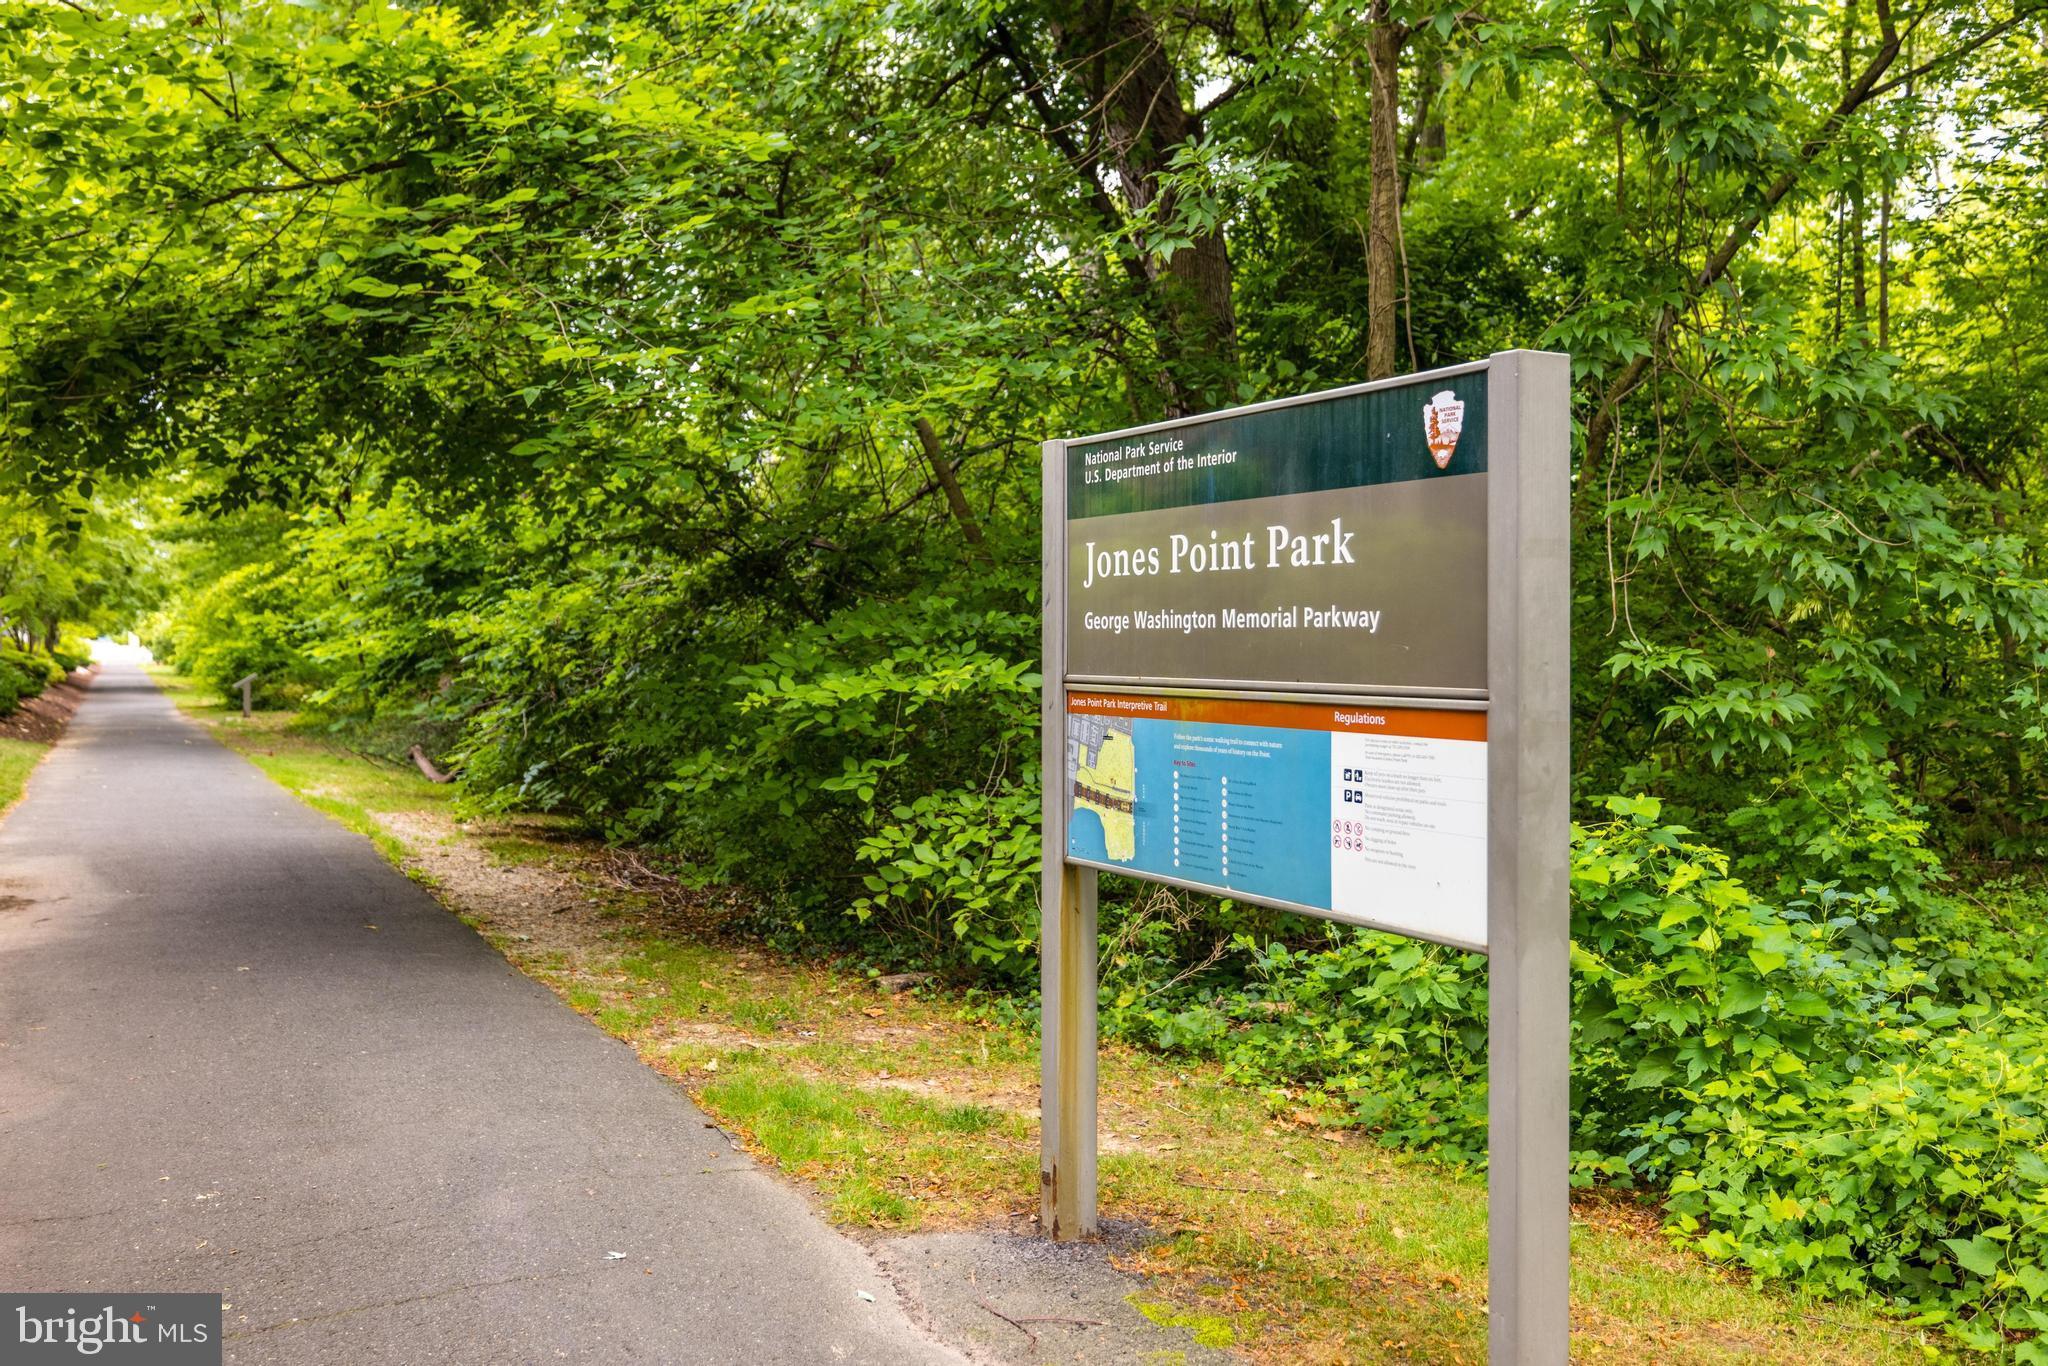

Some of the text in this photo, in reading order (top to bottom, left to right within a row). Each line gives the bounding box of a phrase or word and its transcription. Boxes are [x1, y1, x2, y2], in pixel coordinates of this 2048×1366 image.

[1085, 438, 1183, 466] National Park Service
[1085, 449, 1237, 484] U.S. Department of the Interior
[1083, 518, 1355, 588] Jones Point Park
[1084, 605, 1380, 634] George Washington Memorial Parkway
[1071, 697, 1167, 711] Jones Point Park Interpretive Trail
[1334, 712, 1385, 726] Regulations
